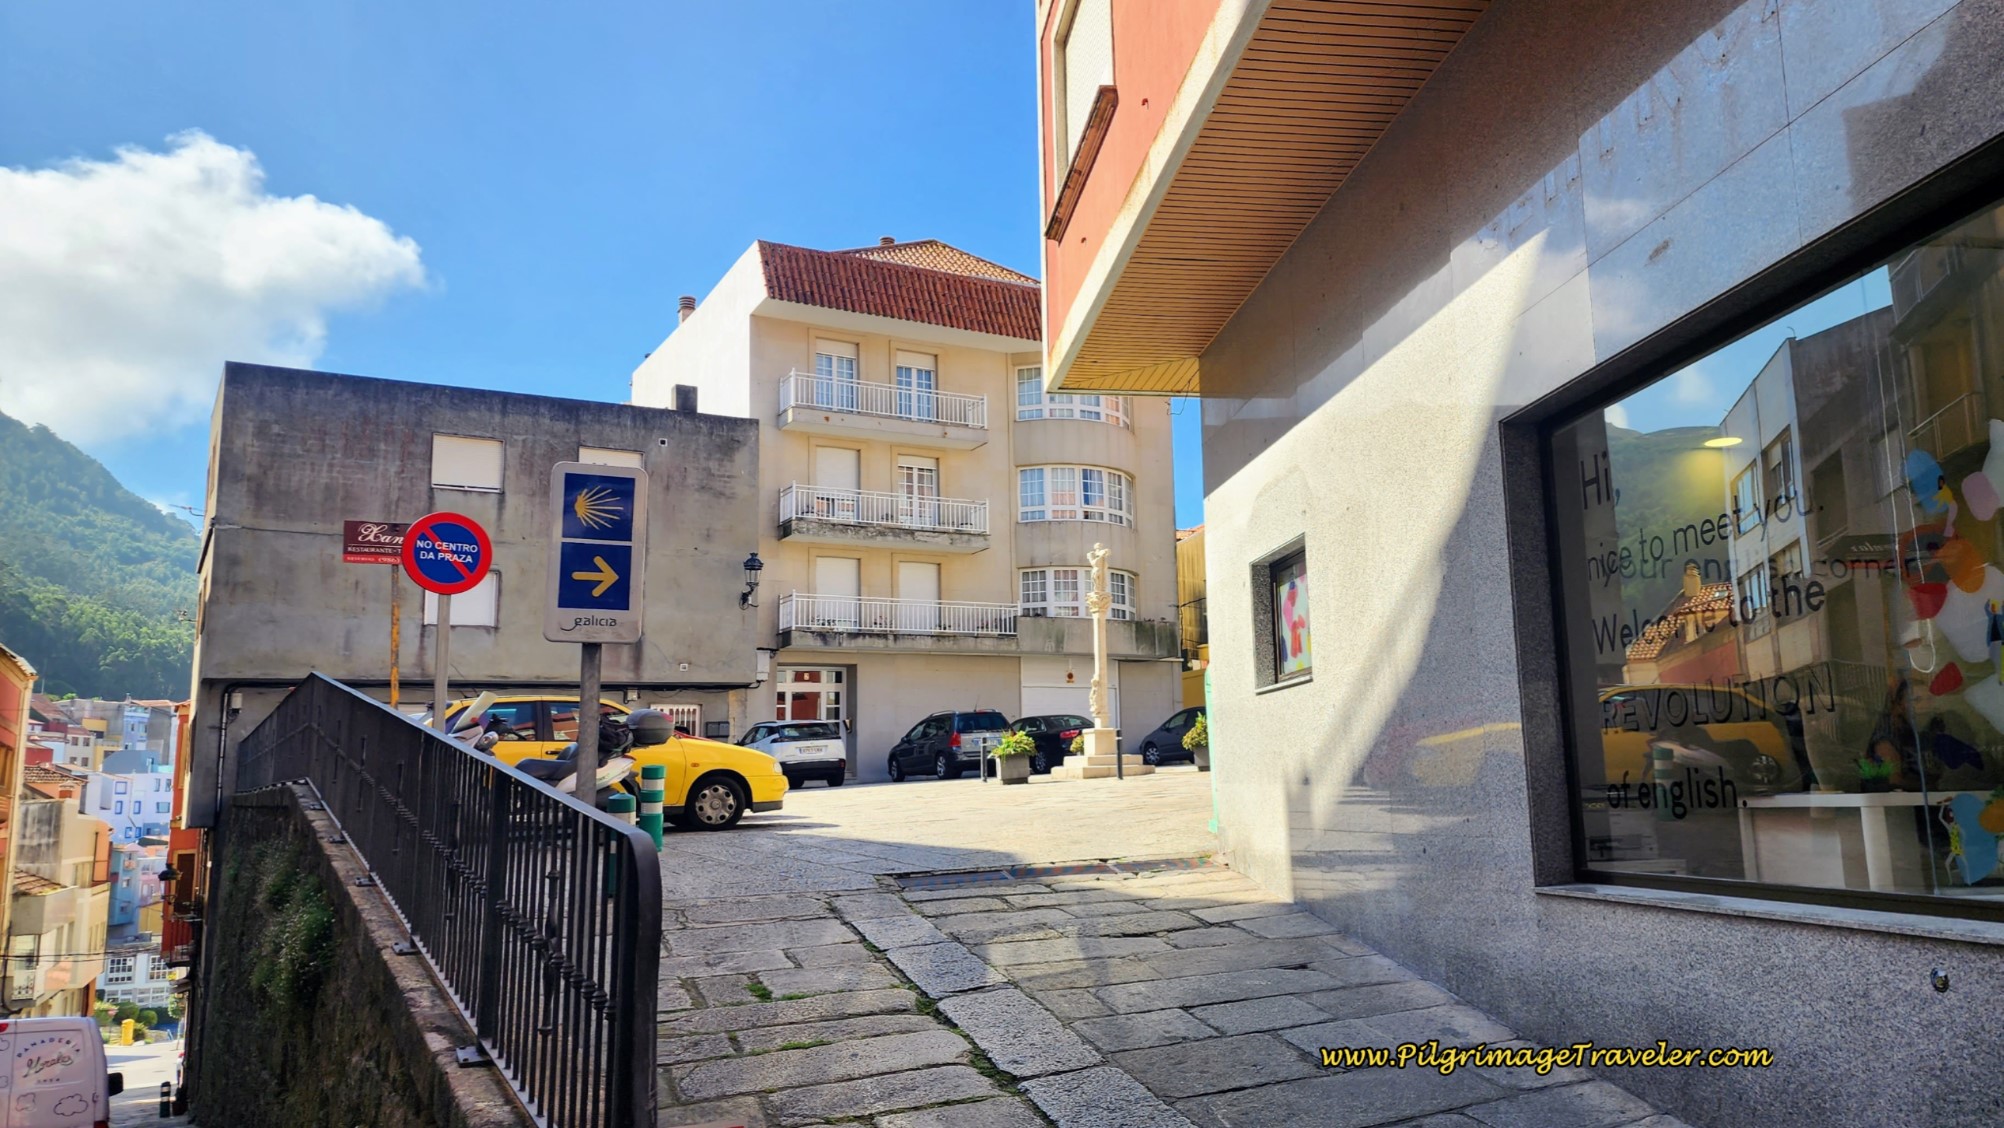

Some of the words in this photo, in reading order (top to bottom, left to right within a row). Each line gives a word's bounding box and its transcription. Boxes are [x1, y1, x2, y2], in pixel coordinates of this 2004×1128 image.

[1580, 451, 1620, 510] Hi,
[358, 523, 404, 545] Xan
[416, 539, 432, 550] NO
[435, 541, 479, 553] CENTRO
[1588, 542, 1632, 581] nice
[1639, 528, 1664, 564] to
[1673, 495, 1743, 556] meet
[1754, 486, 1824, 542] you.
[419, 551, 435, 560] DA
[438, 553, 473, 564] PRAZA
[1770, 574, 1826, 618] the
[560, 615, 617, 631] galicia
[1603, 662, 1836, 735] REVOLUTION
[1607, 770, 1632, 810] of
[1638, 766, 1748, 820] english.
